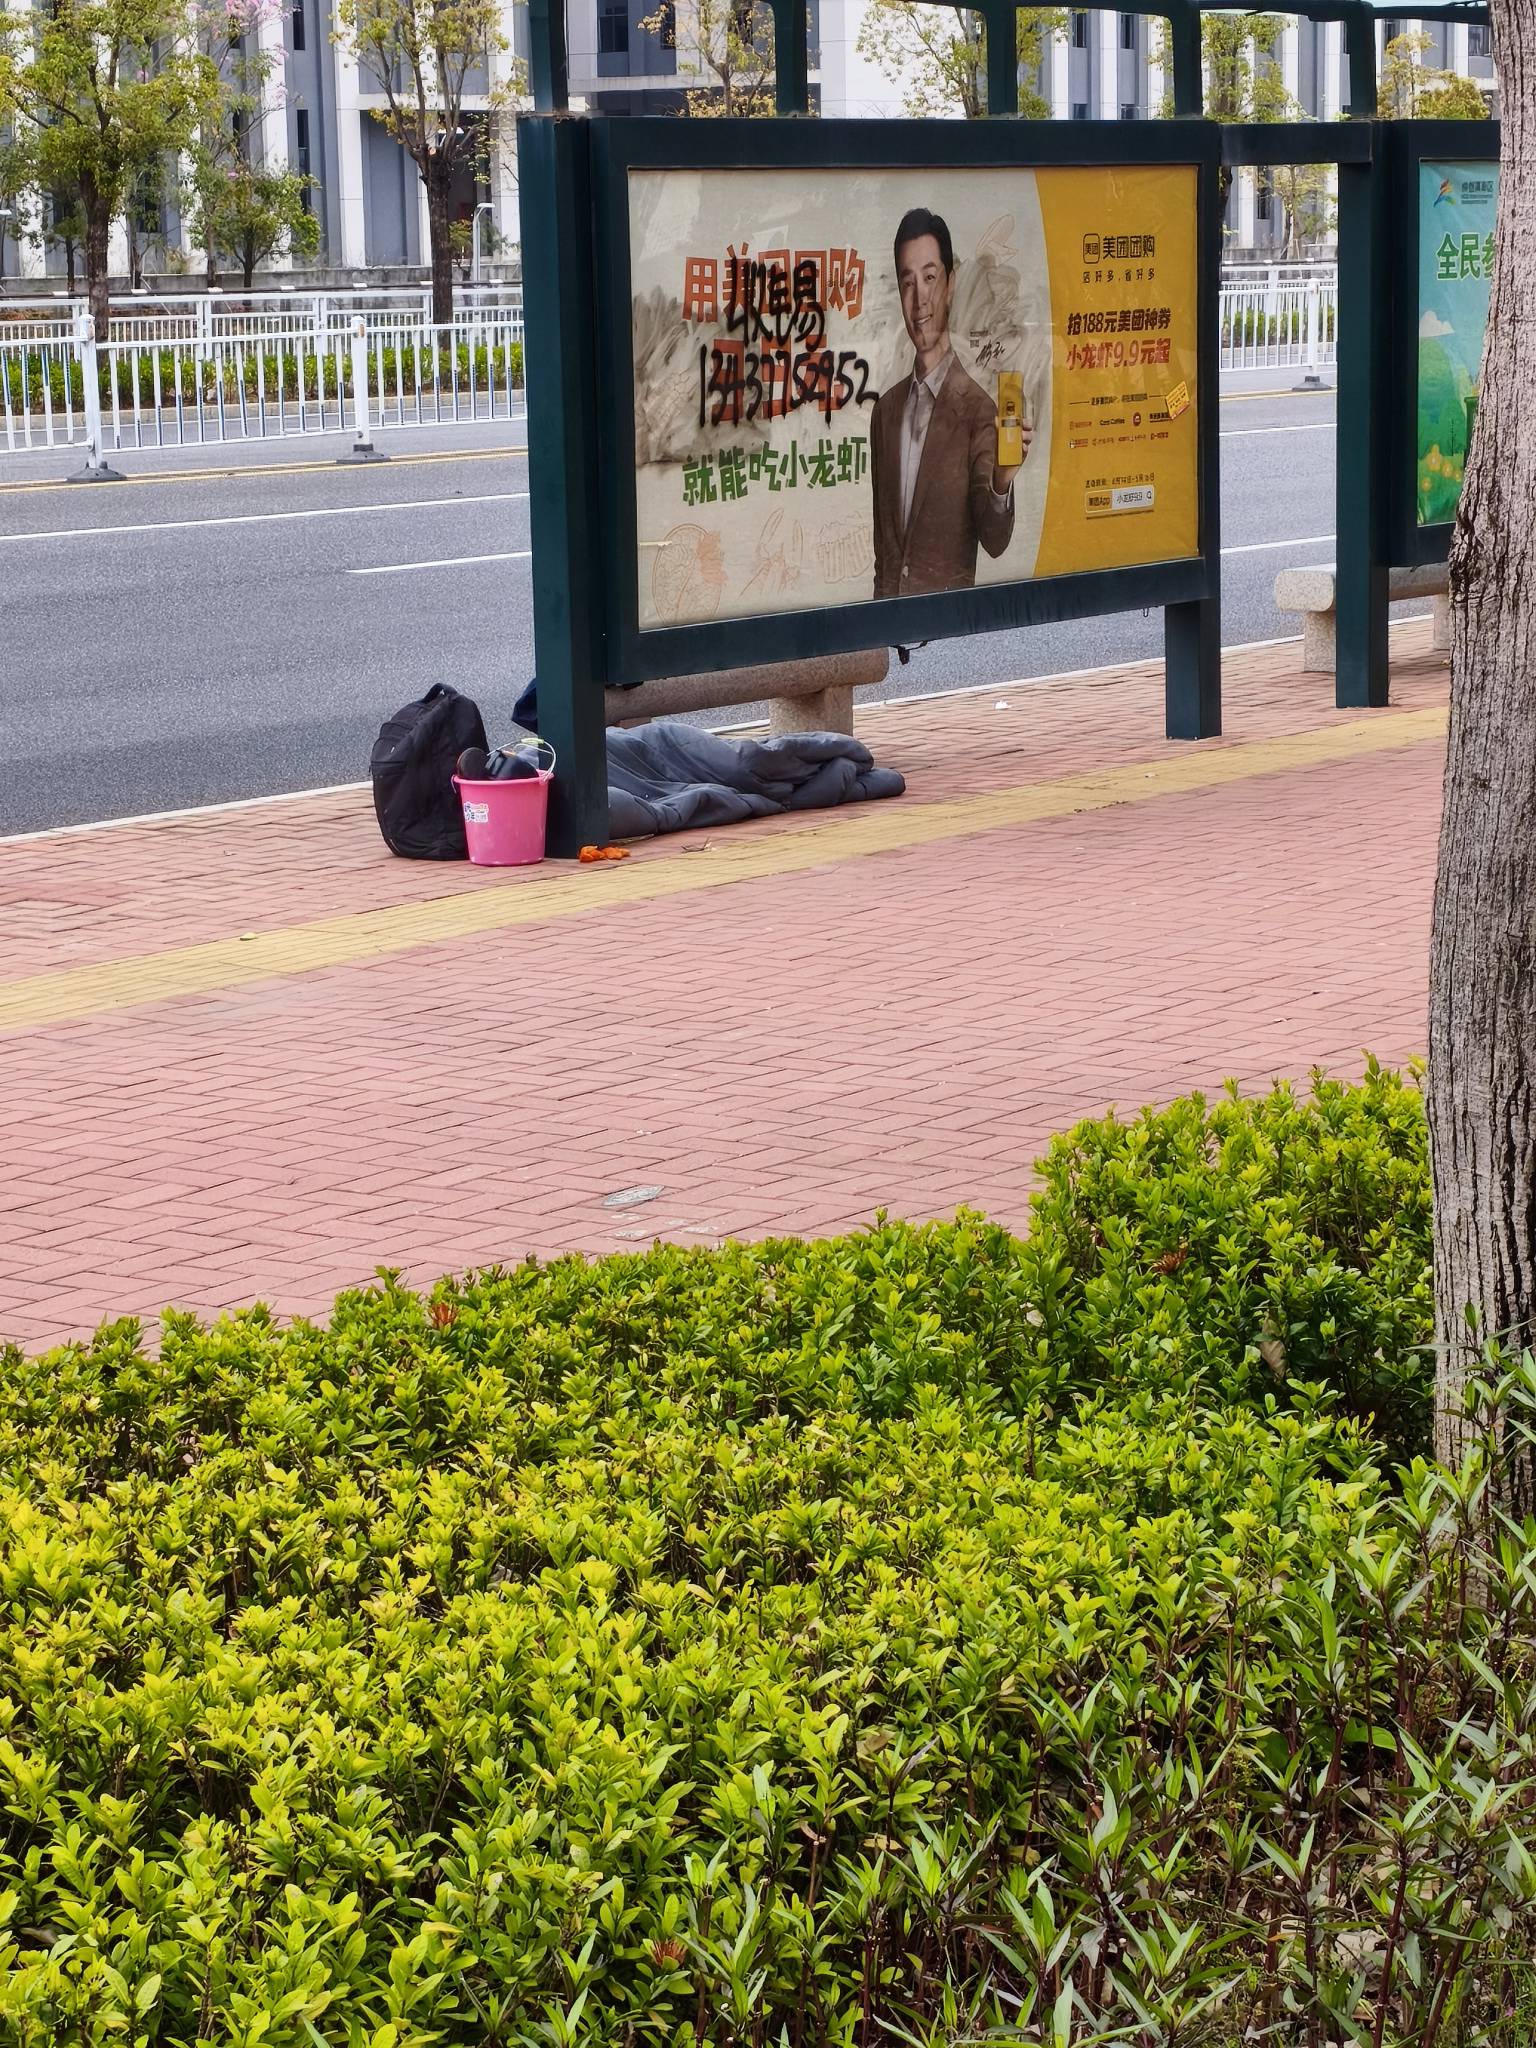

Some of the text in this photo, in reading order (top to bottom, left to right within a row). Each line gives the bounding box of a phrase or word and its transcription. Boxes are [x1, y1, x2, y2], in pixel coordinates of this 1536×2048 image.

[1102, 234, 1155, 259] 美团团购
[1067, 307, 1171, 335] 抢188元美团神券
[1066, 338, 1171, 370] 小龙虾9.9元起
[682, 437, 867, 506] 就能吃小龙虾
